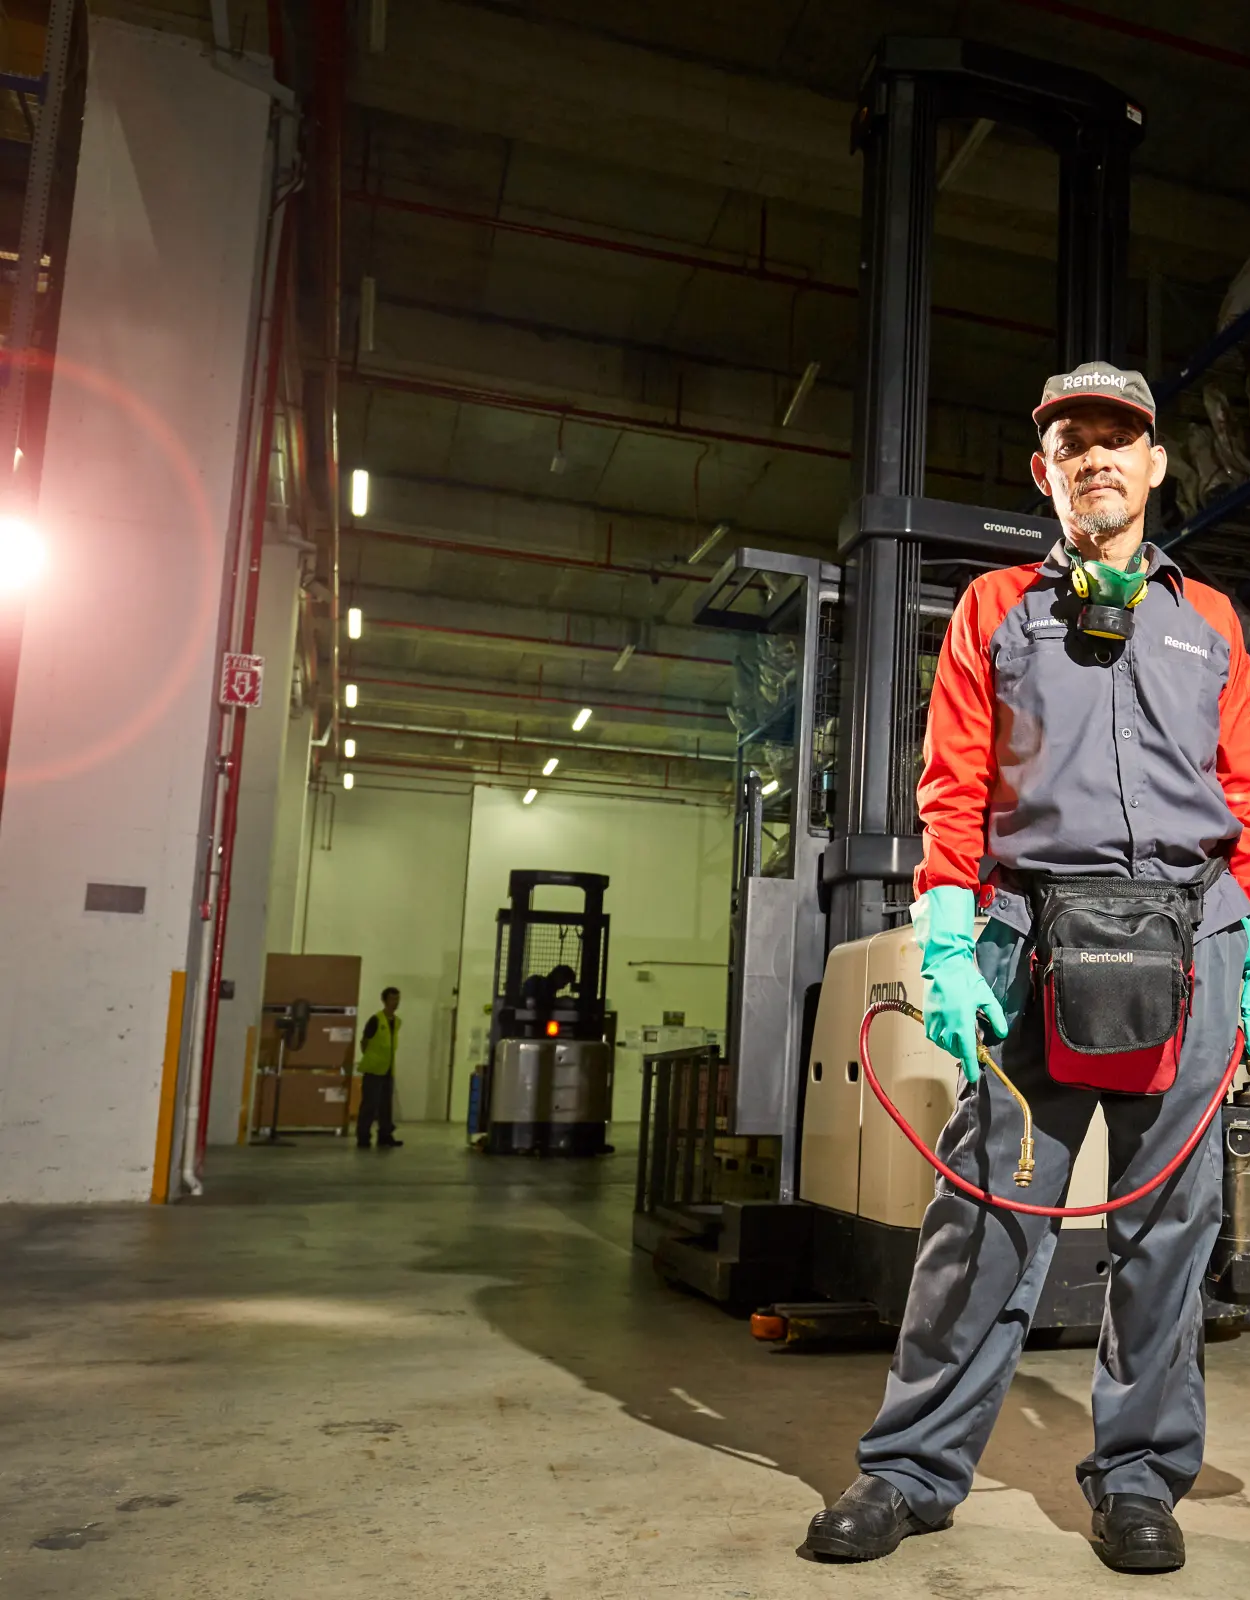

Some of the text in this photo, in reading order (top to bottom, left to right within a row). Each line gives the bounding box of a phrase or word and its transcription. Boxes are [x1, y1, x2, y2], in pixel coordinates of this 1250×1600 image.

[1062, 371, 1127, 391] Rentokil
[983, 522, 1042, 539] crown.com
[1026, 619, 1049, 631] JAFFAR
[1164, 635, 1208, 659] Rentokil
[1080, 951, 1134, 963] Rentokil
